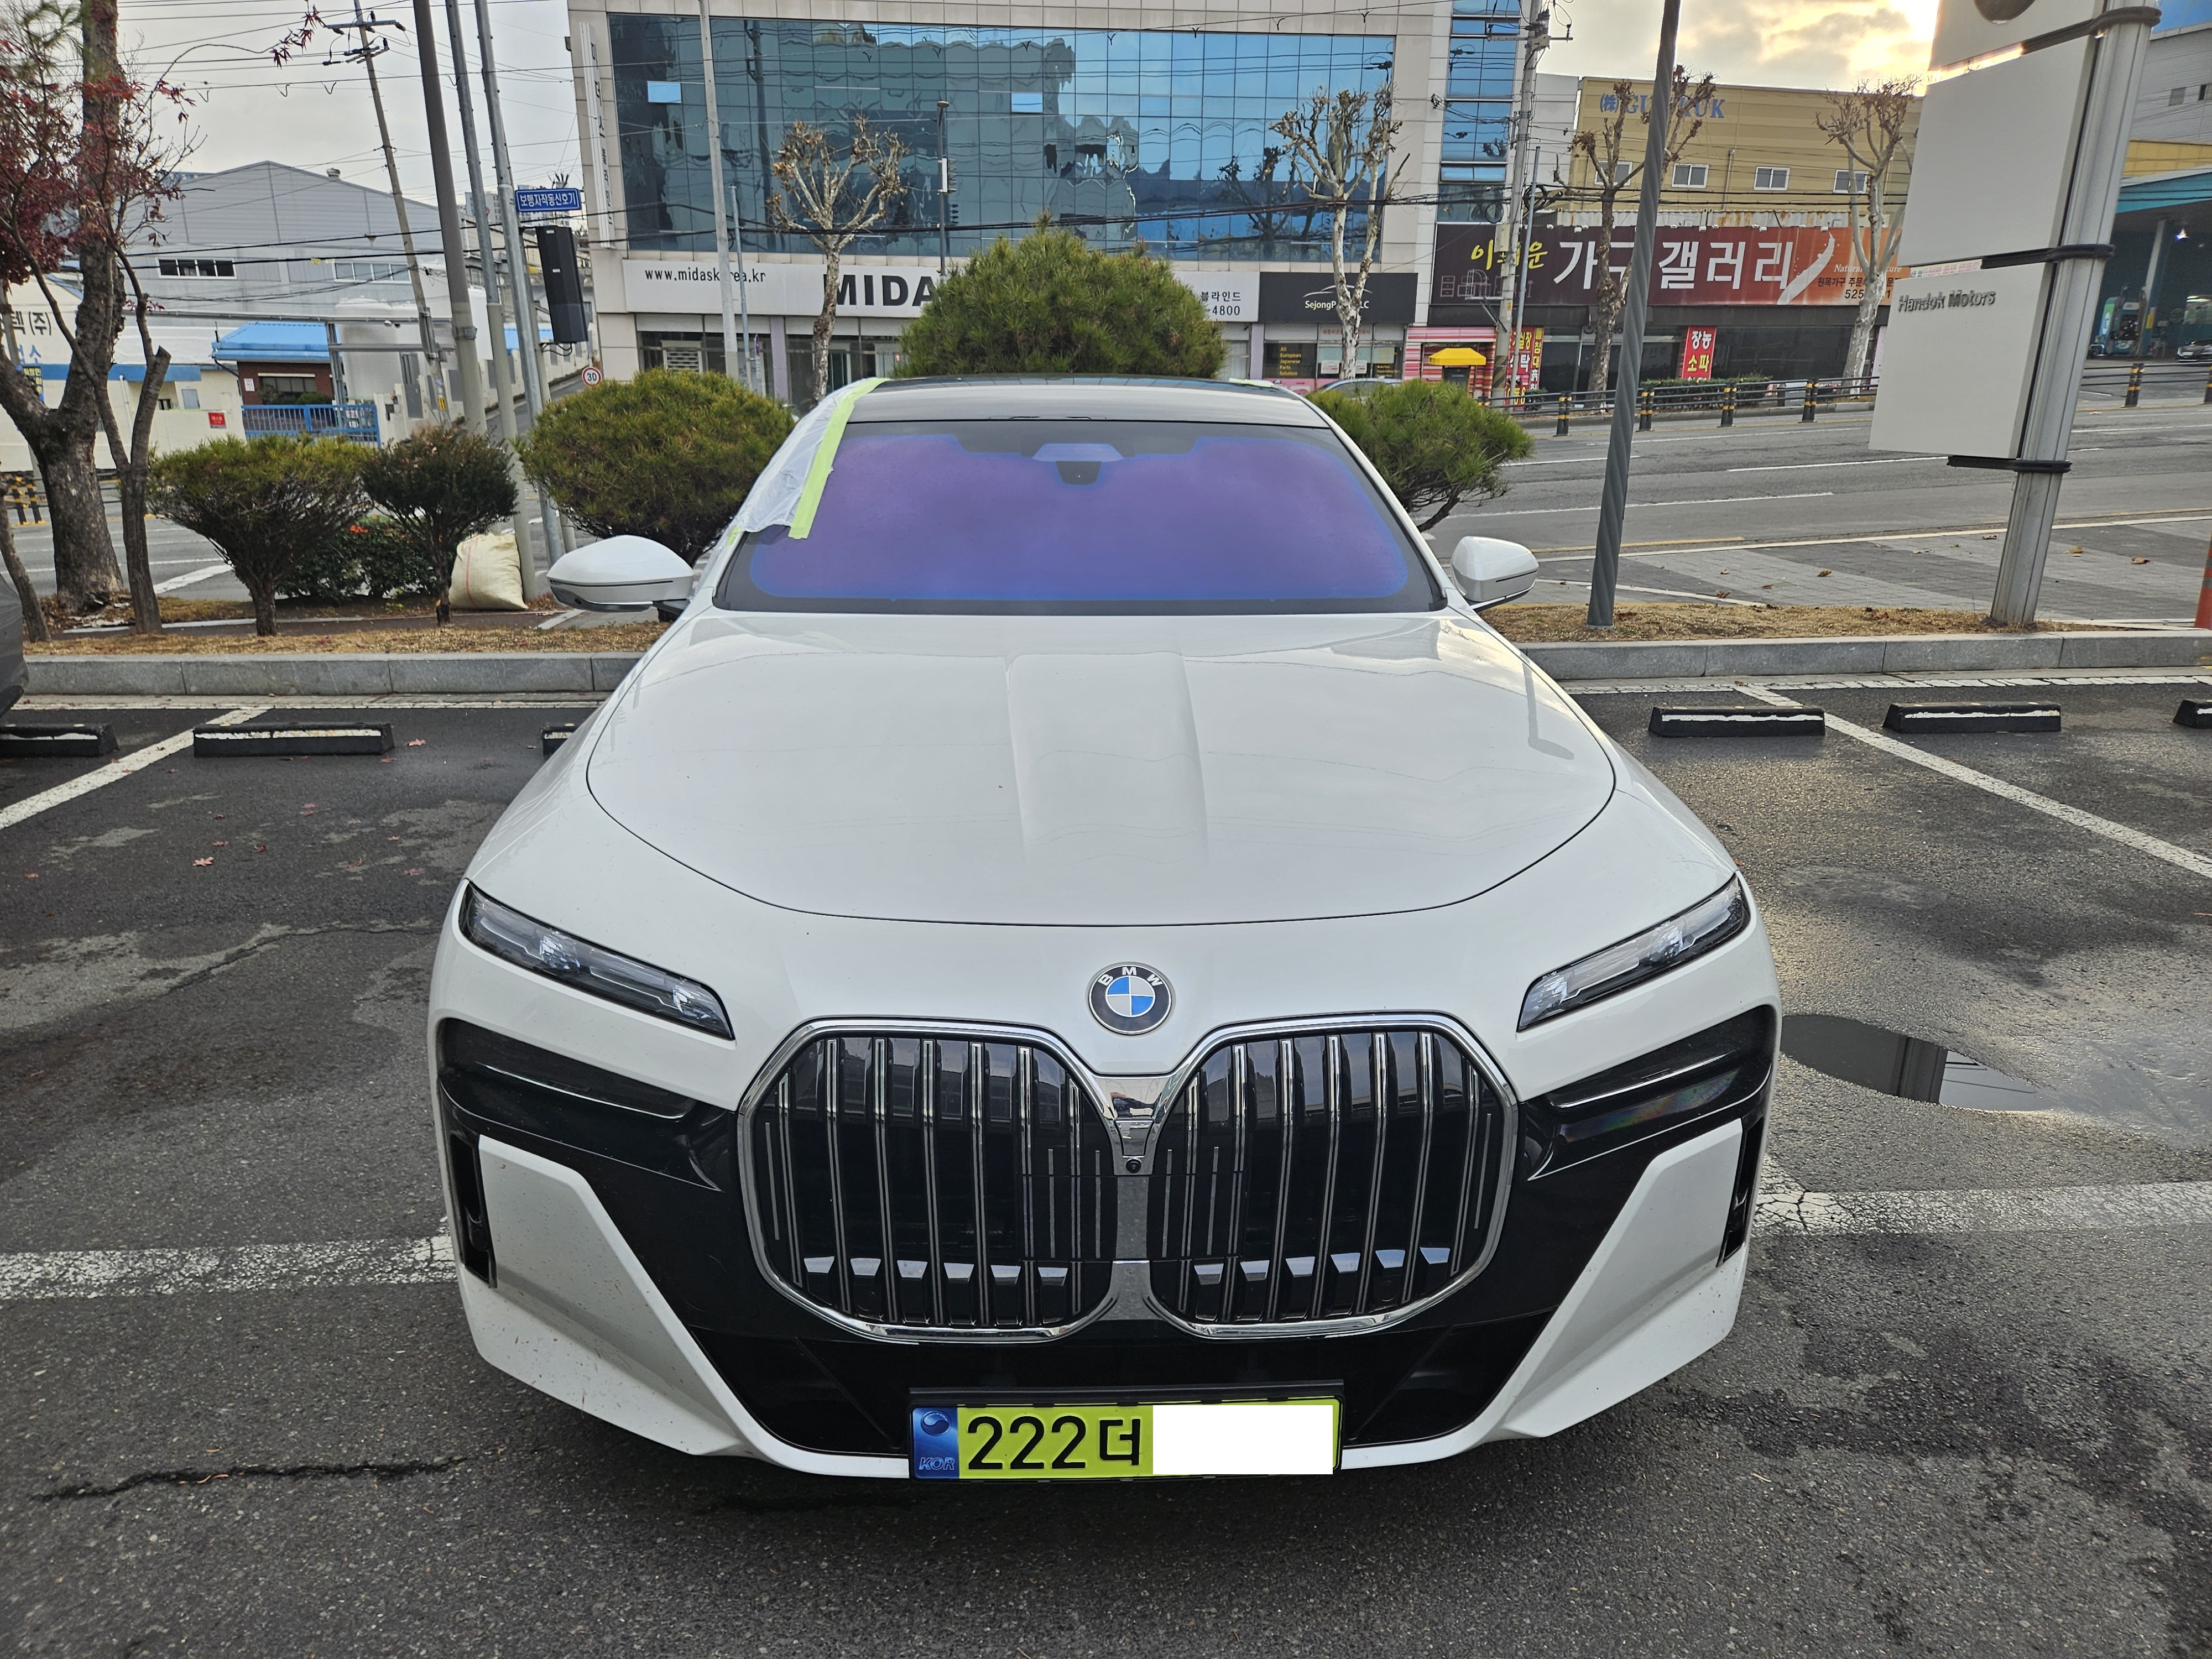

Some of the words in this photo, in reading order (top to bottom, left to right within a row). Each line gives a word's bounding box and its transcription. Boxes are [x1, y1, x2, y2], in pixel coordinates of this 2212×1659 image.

[520, 192, 576, 207] 보행자작동신호기
[1471, 239, 1548, 270] 이운
[645, 267, 765, 283] www.midaskea.kr
[1818, 278, 1845, 287] 원목가구
[1849, 277, 1865, 287] 주문
[1201, 291, 1241, 302] 블라인드
[1845, 289, 1864, 299] 525
[1898, 291, 1946, 312] Handok
[1947, 289, 1996, 307] Motors
[1305, 300, 1337, 311] SejongP
[1692, 330, 1712, 350] 장농
[1687, 354, 1709, 372] 소파
[587, 373, 597, 382] 30
[1098, 967, 1163, 987] BMW
[967, 1415, 1141, 1470] 222더
[919, 1457, 956, 1470] KOR
